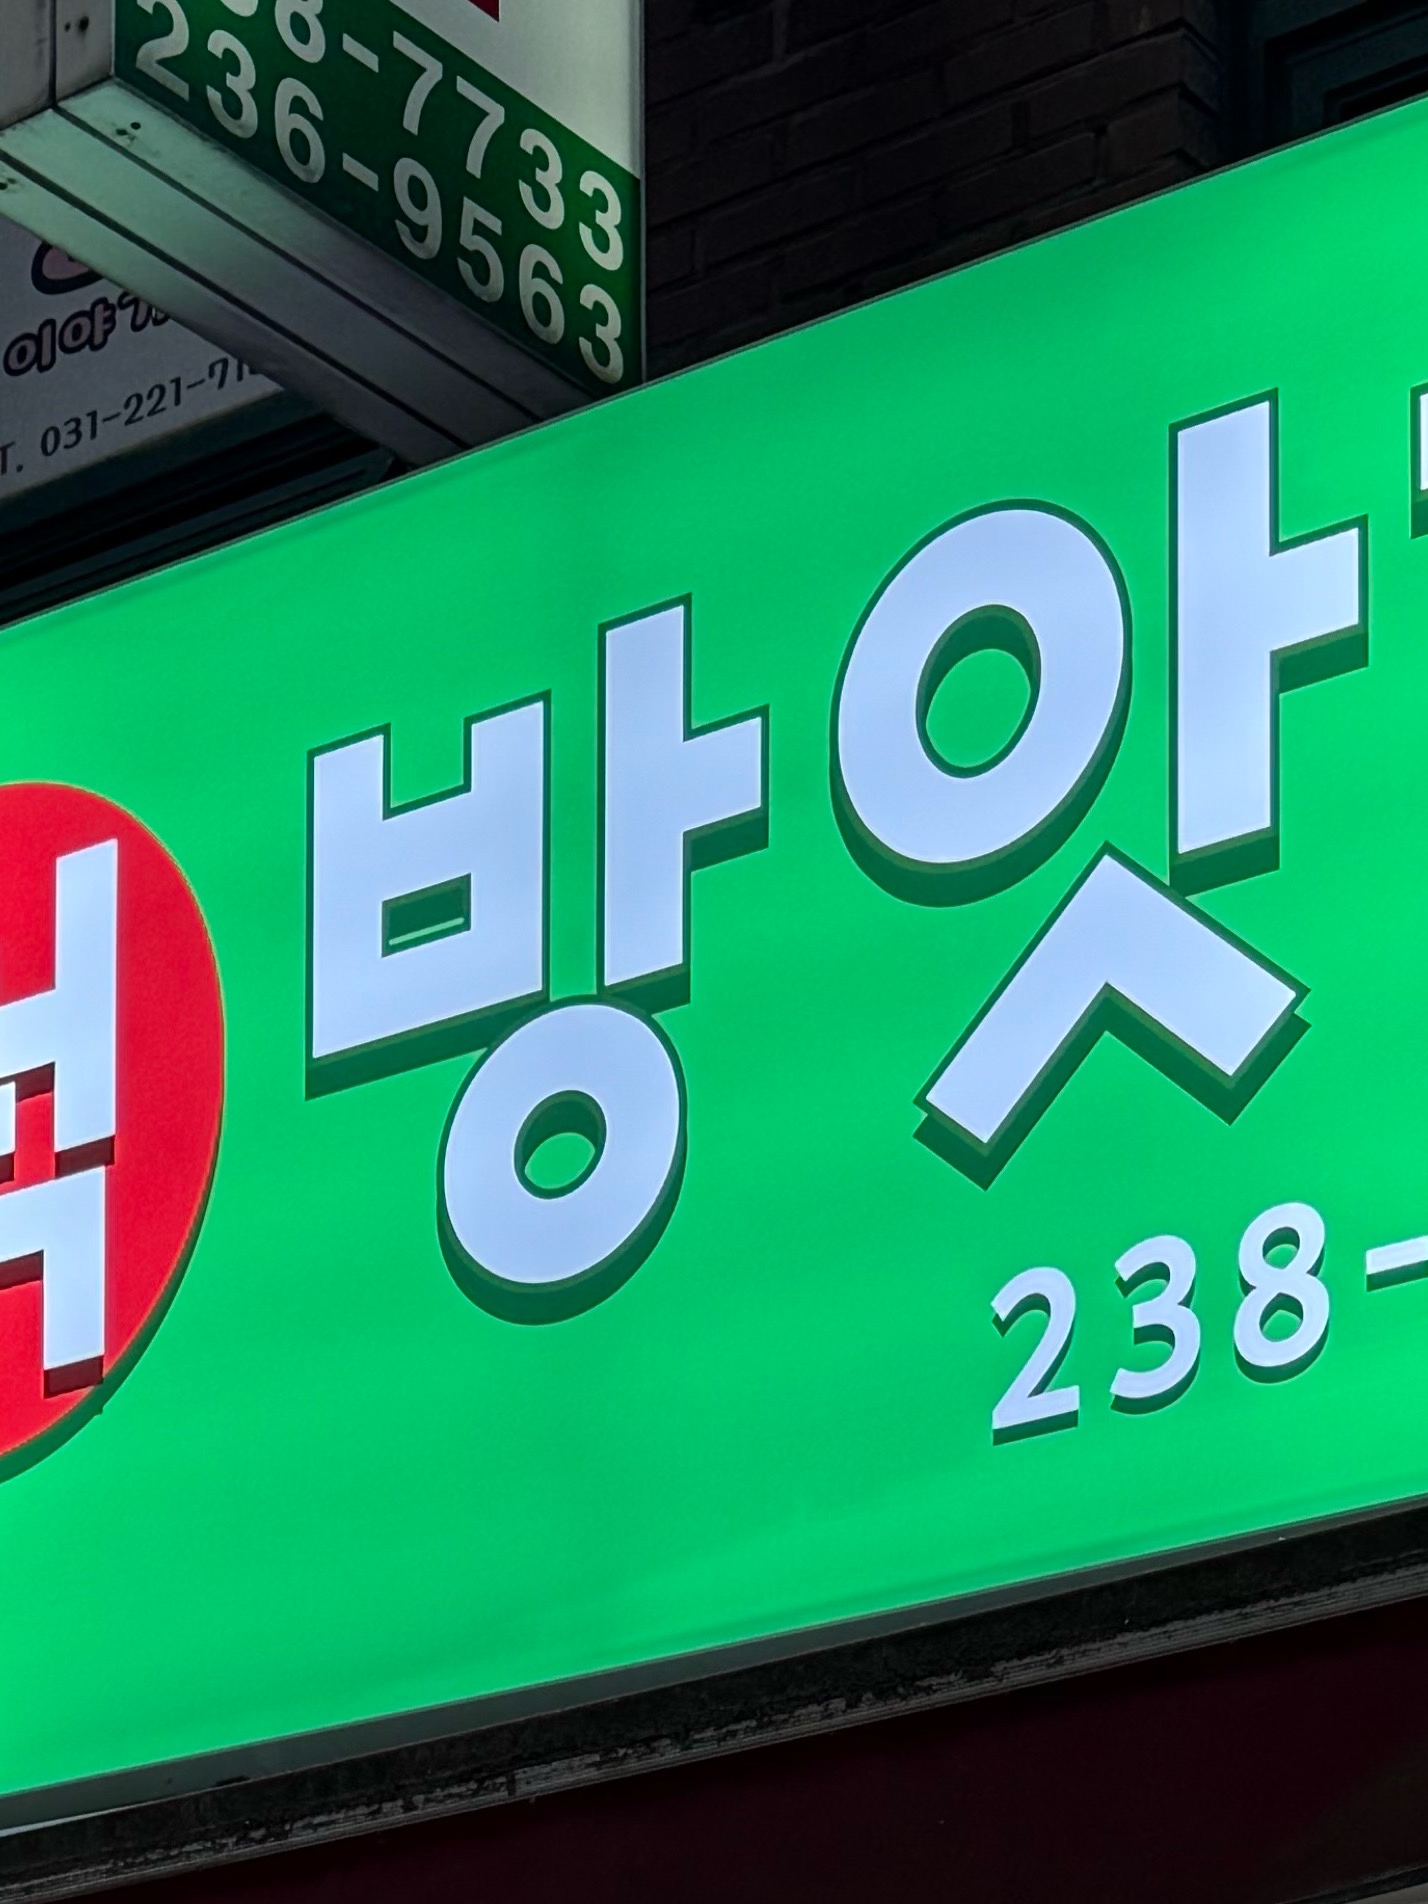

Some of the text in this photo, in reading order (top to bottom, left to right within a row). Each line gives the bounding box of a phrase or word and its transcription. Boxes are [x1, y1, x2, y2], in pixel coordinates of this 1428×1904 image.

[136, 0, 624, 384] 236-9563
[220, 0, 624, 271] 8-7733
[39, 357, 258, 457] 031-221-7
